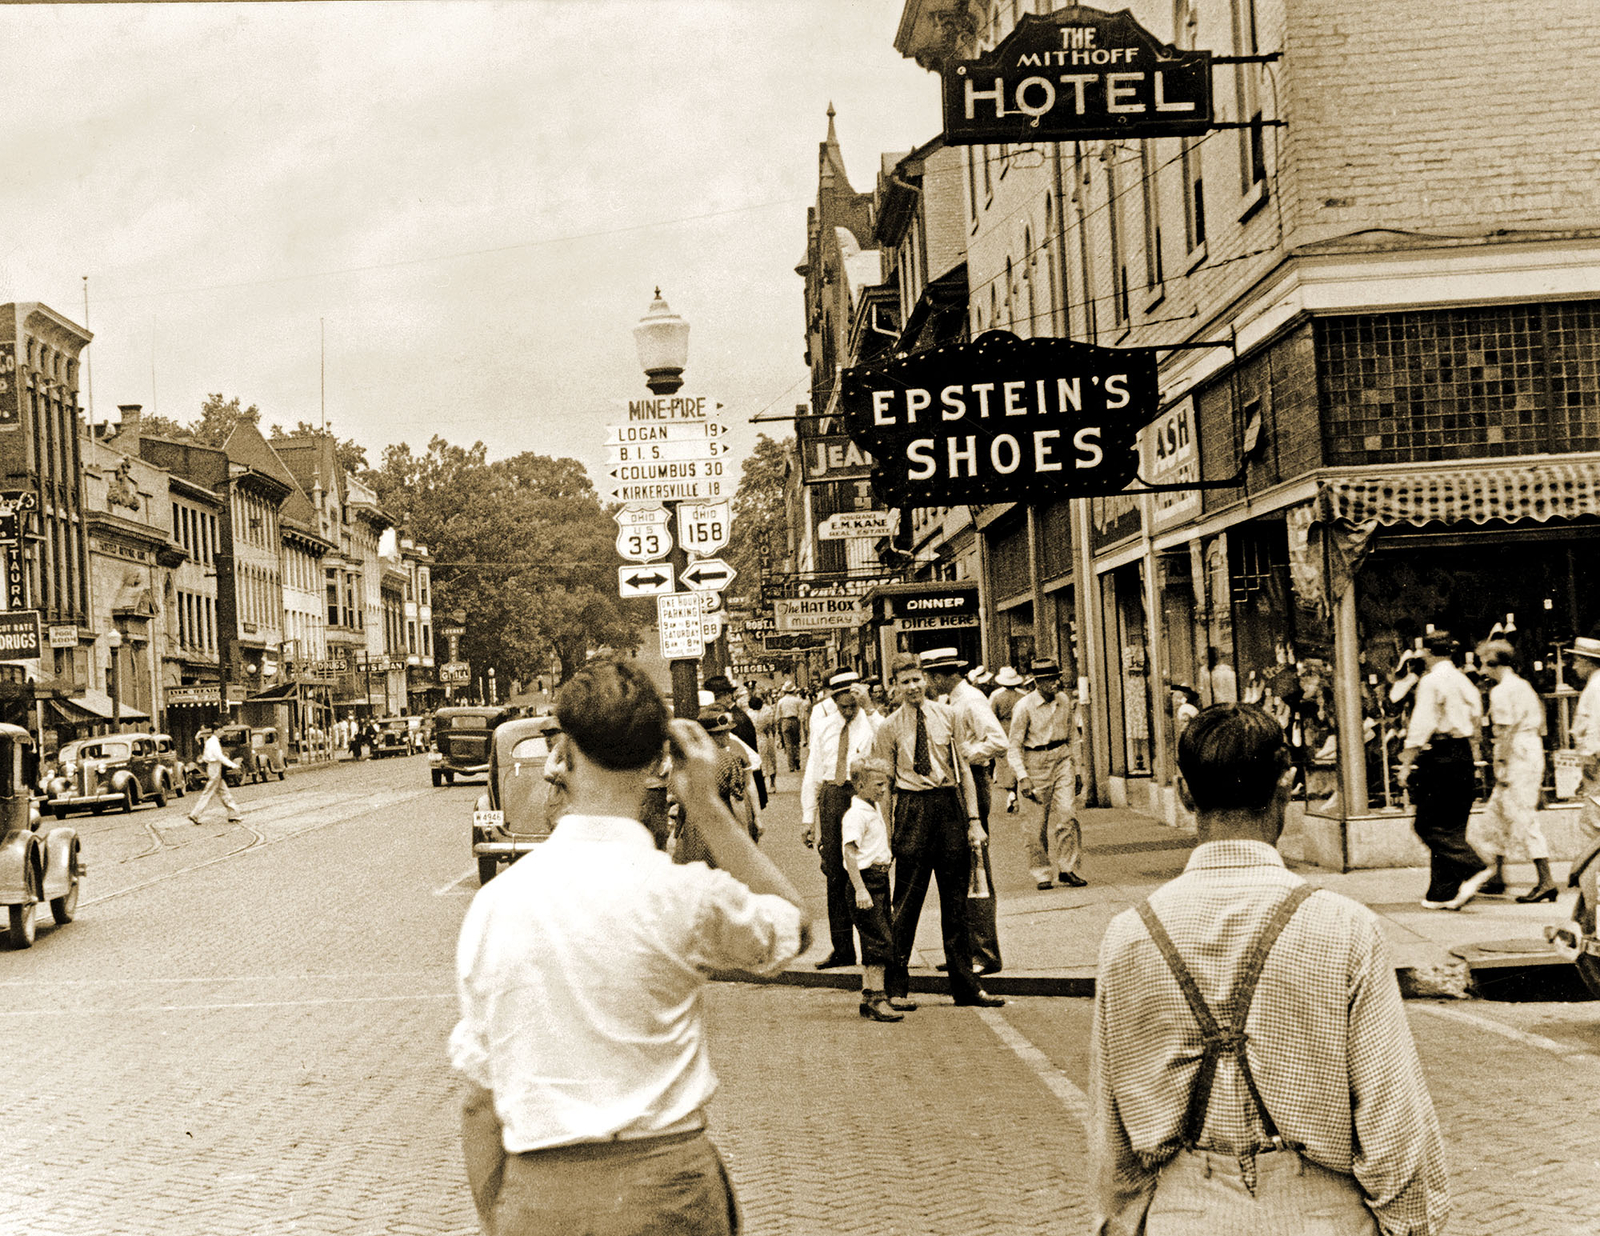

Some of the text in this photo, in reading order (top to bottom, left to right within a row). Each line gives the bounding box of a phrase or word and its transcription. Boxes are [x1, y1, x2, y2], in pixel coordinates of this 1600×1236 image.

[1060, 27, 1097, 49] THE
[1016, 47, 1139, 67] MITHOFF
[964, 71, 1195, 119] HOTEL
[872, 373, 1130, 426] EPSTEIN'S
[618, 423, 718, 441] LOGAN 19
[709, 442, 718, 456] 5
[906, 427, 1103, 480] SHOES
[621, 461, 723, 480] COLUMBUS 30
[622, 481, 720, 500] KIRKERSVILLE 18
[631, 513, 655, 522] OHIO
[693, 510, 717, 520] OHIO
[854, 518, 888, 528] KANE
[689, 522, 722, 543] 158
[629, 535, 659, 555] 33
[778, 603, 799, 615] The
[801, 601, 825, 613] HAT
[827, 600, 855, 612] BOX
[907, 597, 965, 610] DINNER
[663, 607, 698, 619] PARKING
[13, 623, 33, 632] RATE
[940, 615, 974, 626] HERE
[664, 630, 699, 639] SATURDAY
[441, 670, 469, 680] GILL
[733, 663, 775, 673] SIEGEL'S
